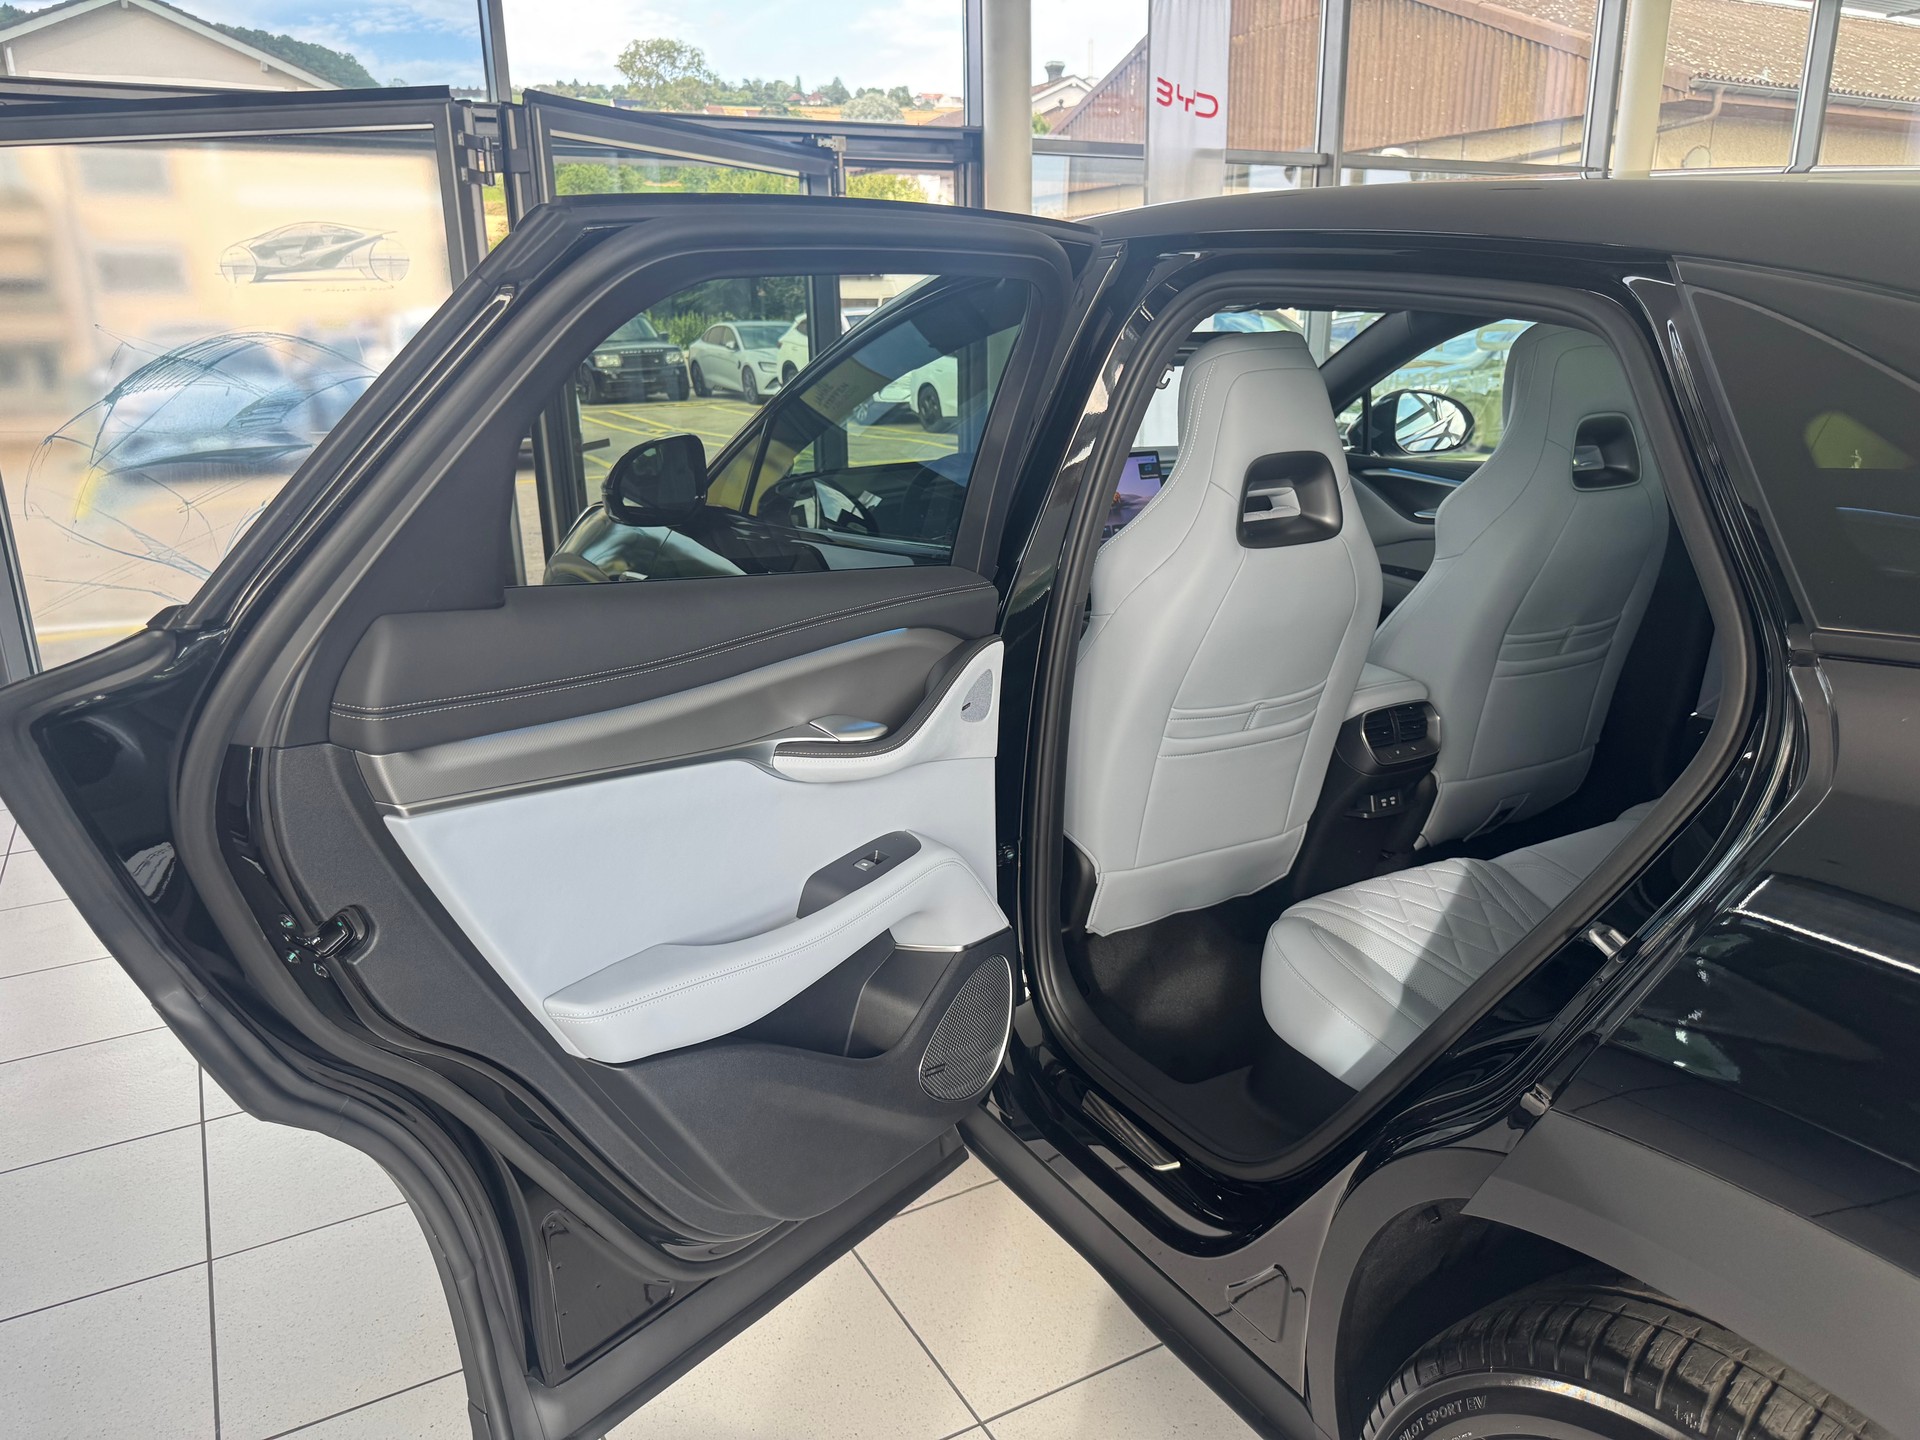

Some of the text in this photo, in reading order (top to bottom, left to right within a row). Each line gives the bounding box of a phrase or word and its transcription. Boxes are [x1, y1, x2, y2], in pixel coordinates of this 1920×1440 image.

[1156, 76, 1219, 119] BYD
[1425, 1399, 1462, 1426] SPORT
[1465, 1395, 1487, 1411] EV
